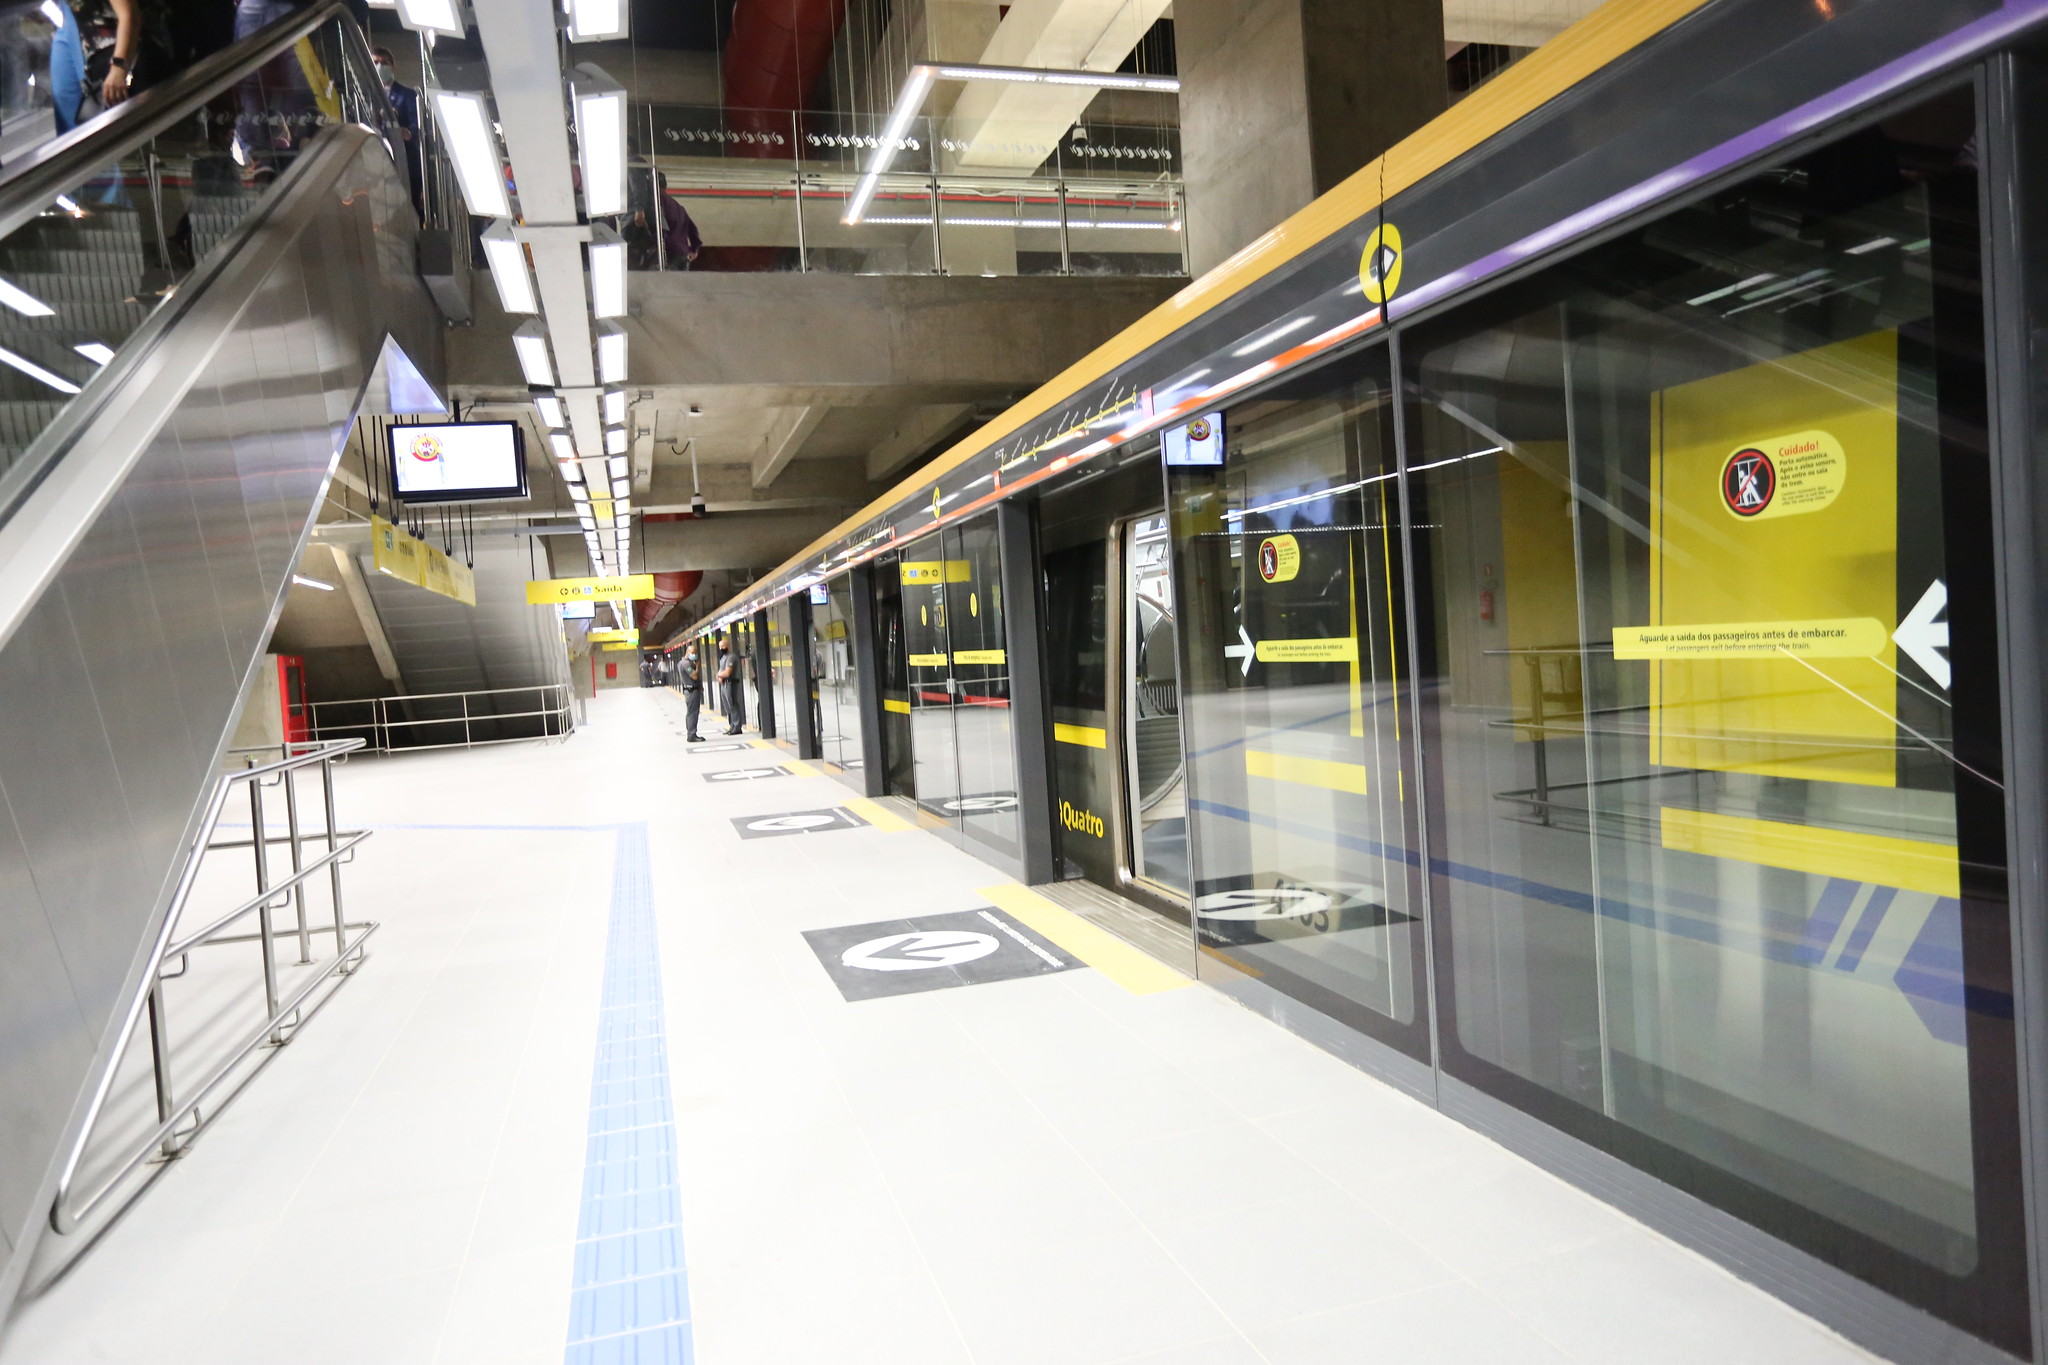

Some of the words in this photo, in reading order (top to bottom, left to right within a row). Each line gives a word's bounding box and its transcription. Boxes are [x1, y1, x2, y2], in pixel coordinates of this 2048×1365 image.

[1779, 440, 1819, 457] Cuidado!
[1780, 458, 1794, 466] Porta
[1780, 466, 1794, 475] Após
[1639, 633, 1668, 643] Aguarde
[1697, 632, 1711, 640] dos
[1713, 630, 1760, 642] passageiros
[1762, 630, 1785, 639] antes
[1788, 628, 1798, 638] de
[1801, 628, 1847, 638] embarcar.
[1725, 643, 1746, 651] before
[1748, 642, 1776, 651] entering
